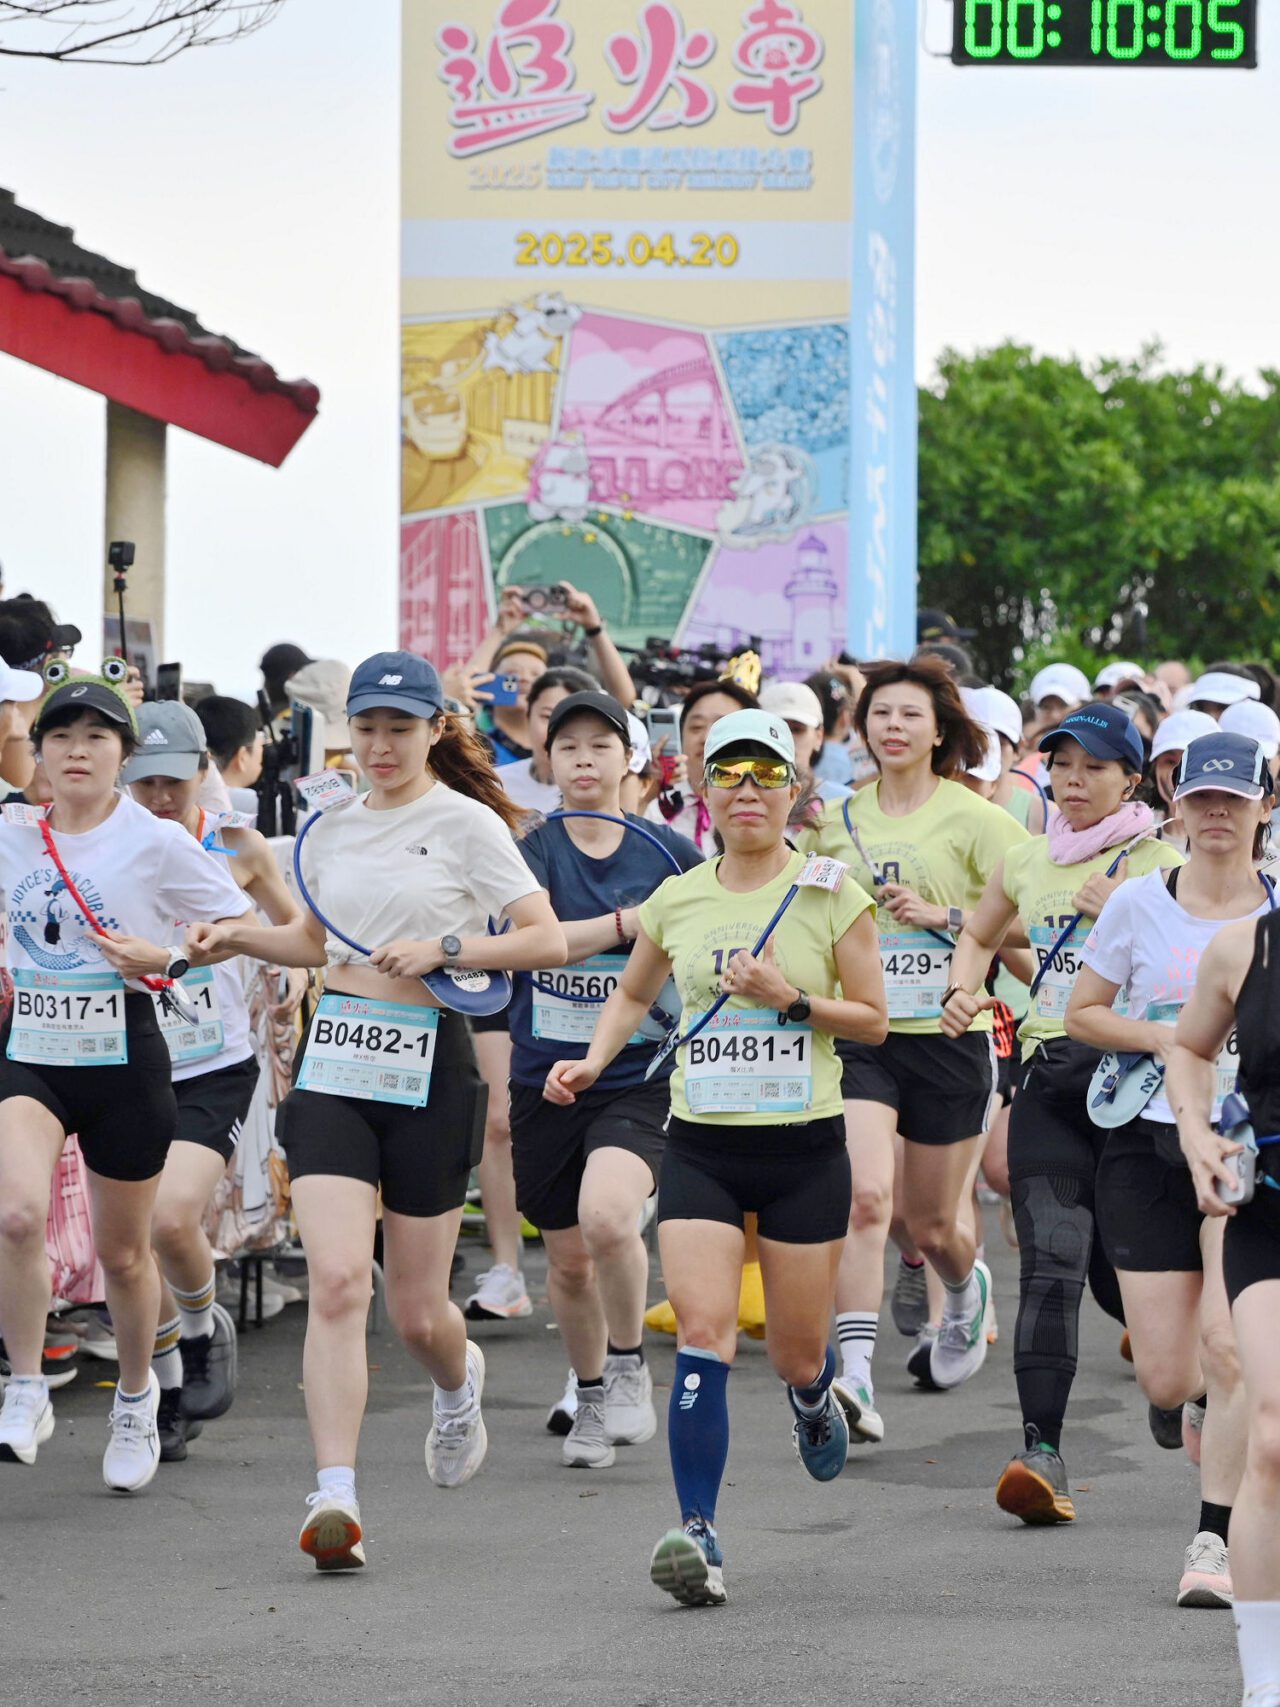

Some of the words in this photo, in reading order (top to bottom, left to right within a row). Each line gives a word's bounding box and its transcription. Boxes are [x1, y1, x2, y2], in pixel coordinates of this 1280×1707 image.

[515, 232, 739, 267] 2025.04.20
[11, 868, 52, 906] JOYCE'S
[79, 878, 104, 912] CLUB
[453, 969, 486, 983] B0482
[881, 953, 953, 976] 429-1
[18, 991, 118, 1020] B0317-1
[314, 1020, 430, 1058] B0482-1
[691, 1035, 805, 1066] B0481-1
